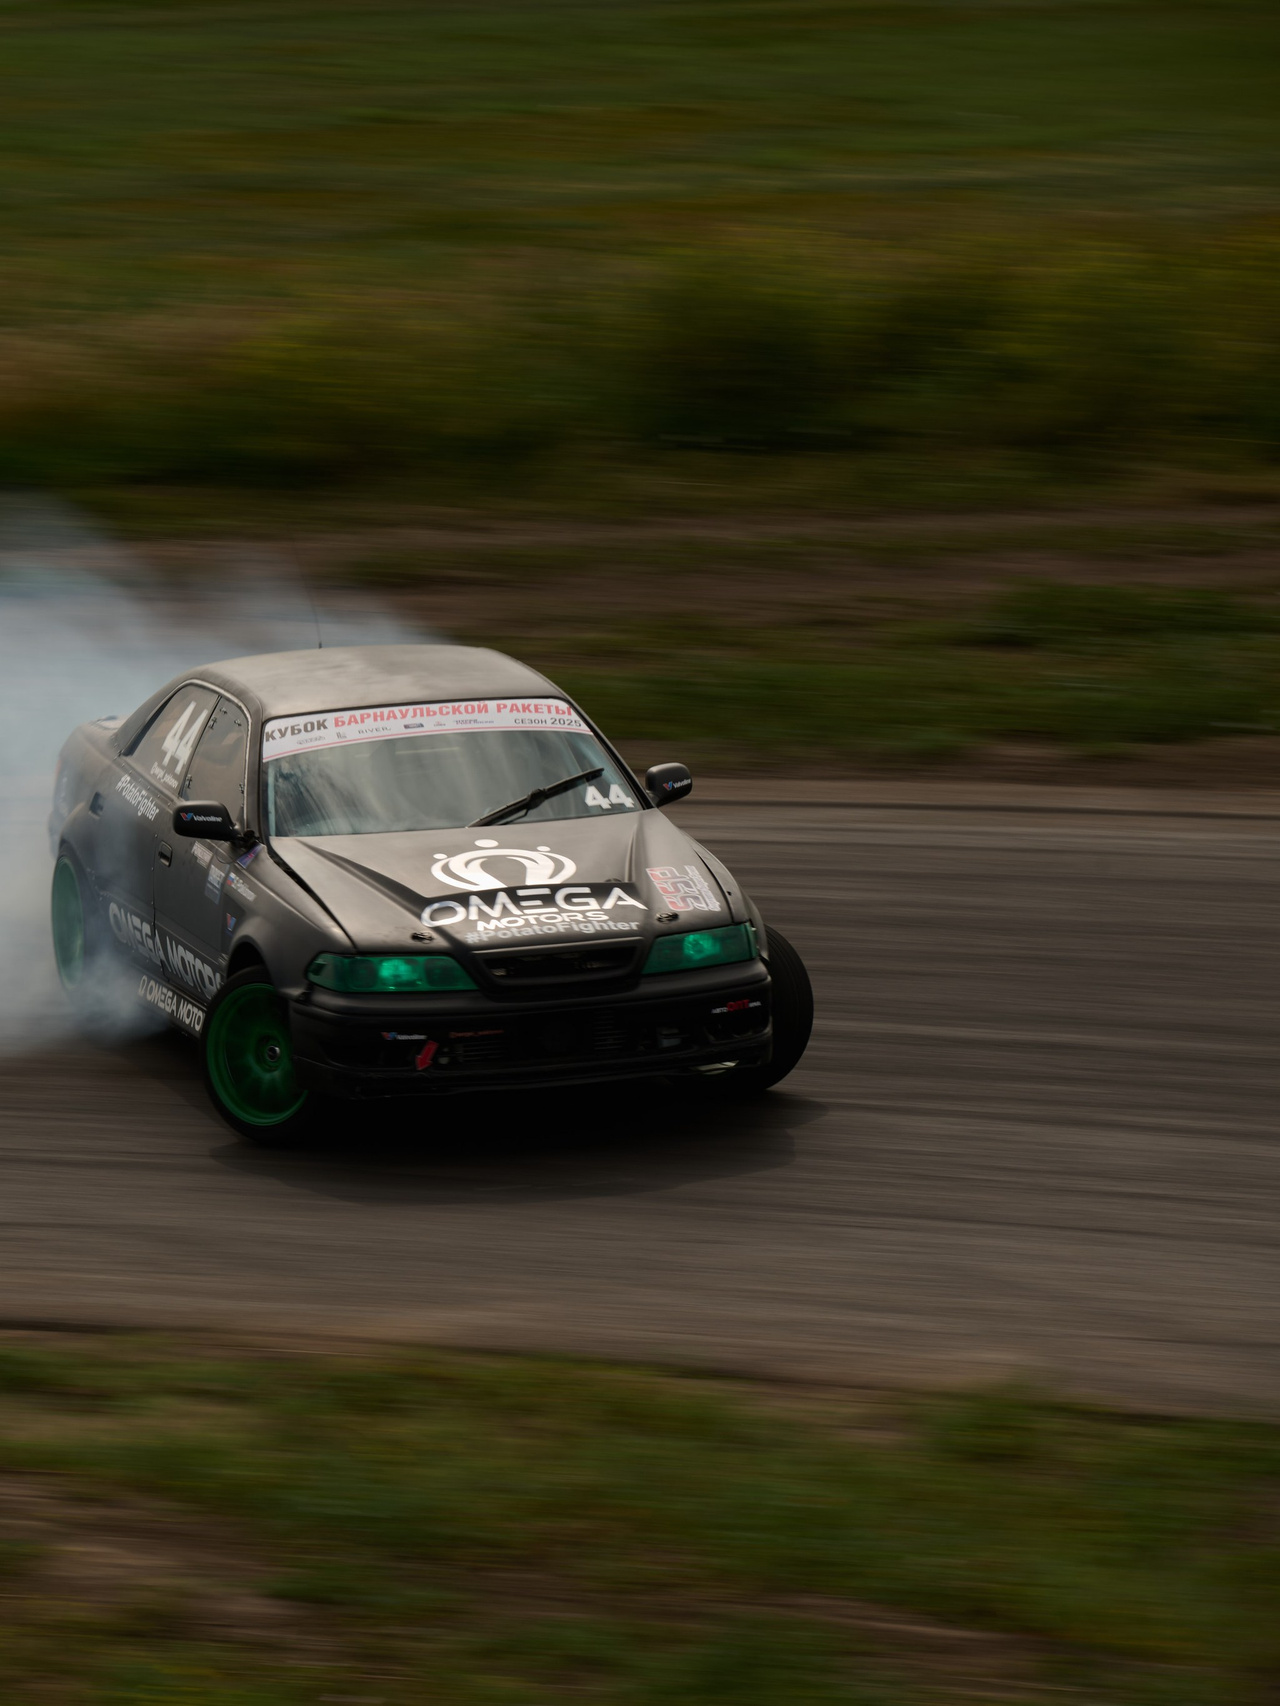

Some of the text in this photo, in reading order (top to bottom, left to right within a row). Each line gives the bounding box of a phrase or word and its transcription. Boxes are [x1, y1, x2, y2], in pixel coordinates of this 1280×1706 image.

[161, 700, 209, 776] 44
[265, 719, 328, 742] КУБОК
[333, 700, 489, 728] БАРНАУЛЬСКОЙ
[497, 702, 572, 716] РАКЕТЫ
[550, 717, 582, 727] 2025
[115, 773, 159, 822] #PotatoFighter
[584, 784, 635, 809] 44
[193, 814, 223, 823] Valvoline
[420, 887, 648, 928] OMEGA
[475, 910, 610, 932] MOTORS
[109, 902, 171, 973] OMEGA
[465, 919, 640, 945] #PotatoFighter
[146, 979, 177, 1017] OMEGA
